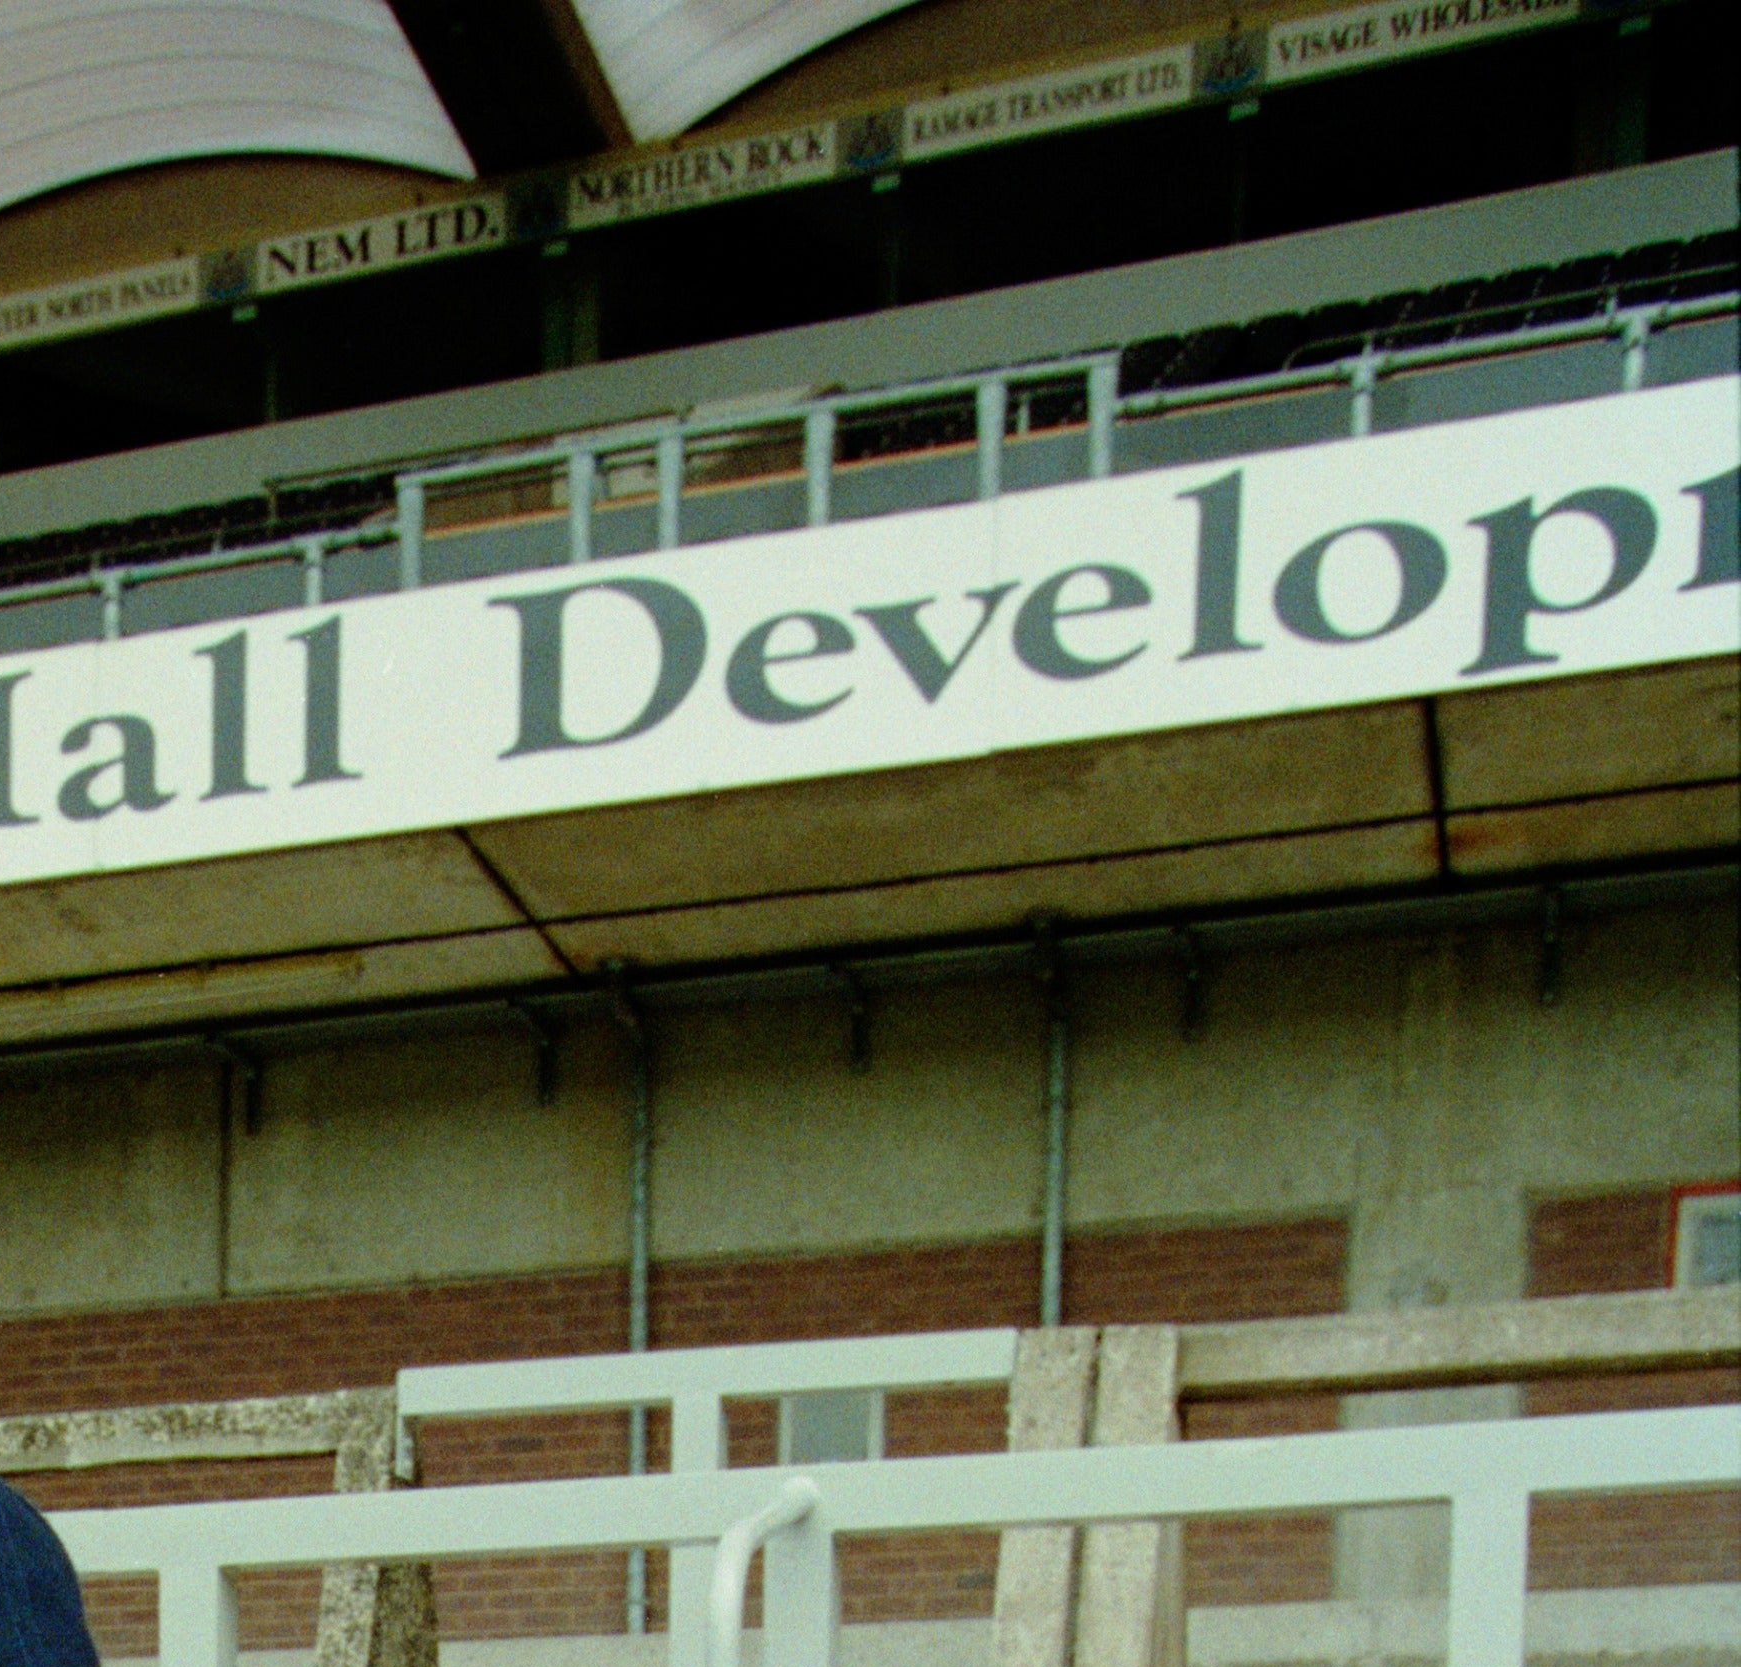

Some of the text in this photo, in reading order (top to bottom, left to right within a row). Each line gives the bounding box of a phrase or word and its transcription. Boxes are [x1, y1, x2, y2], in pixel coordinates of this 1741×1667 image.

[576, 147, 736, 202] NORTHERN
[748, 132, 826, 174] ROCK
[265, 203, 500, 280] NEM LTD.
